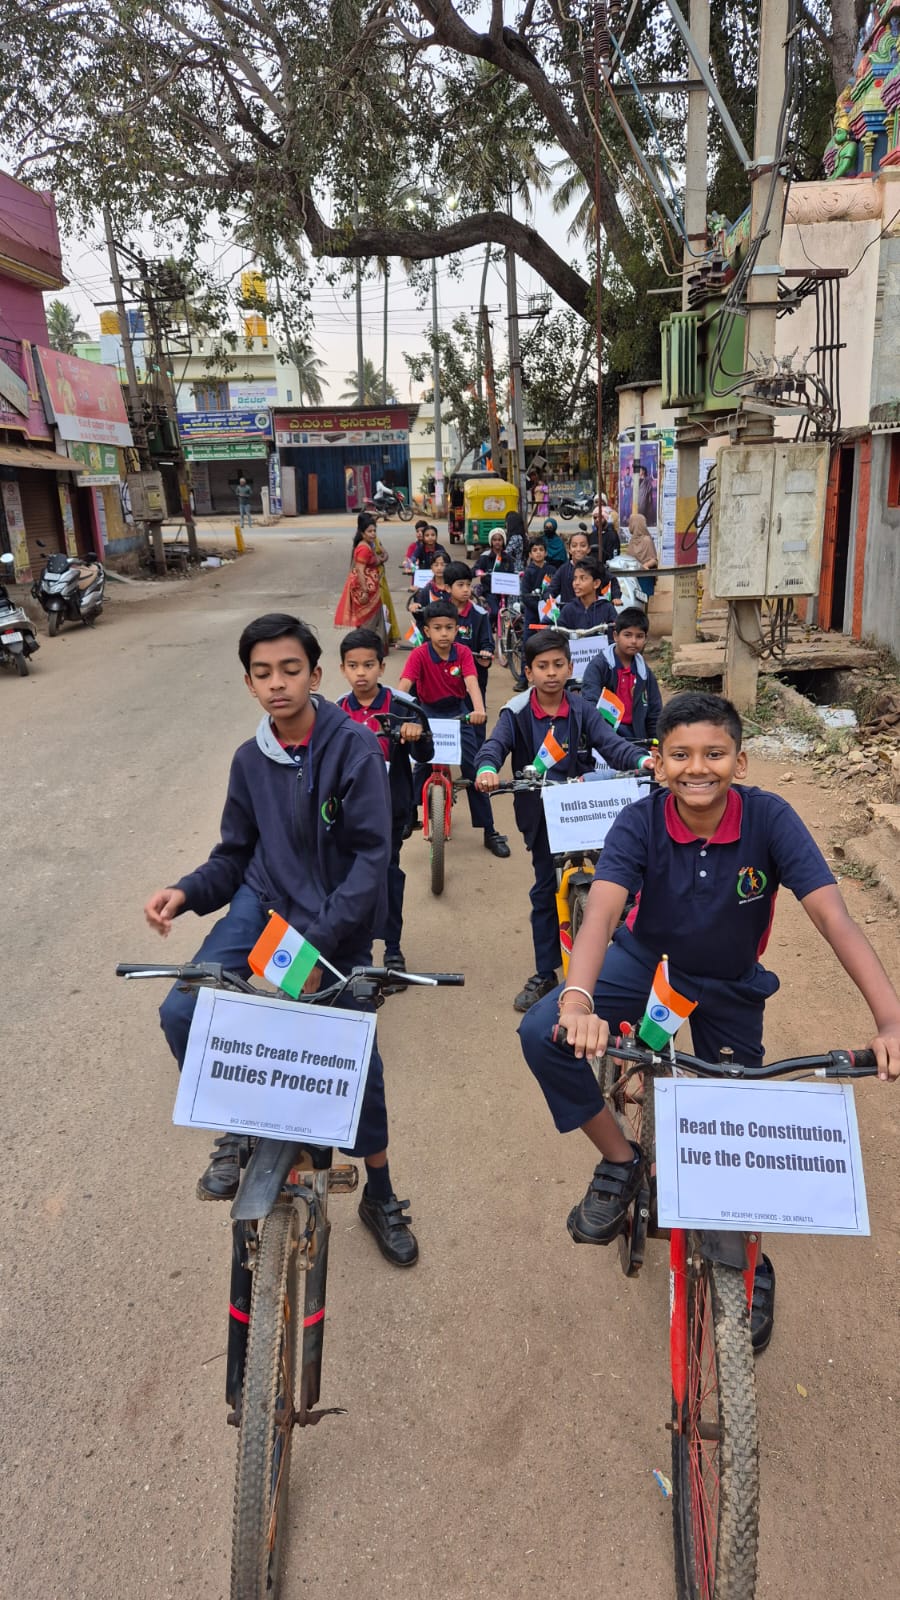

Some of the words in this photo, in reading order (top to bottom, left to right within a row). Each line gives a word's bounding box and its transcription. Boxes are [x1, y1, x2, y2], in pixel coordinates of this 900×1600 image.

[560, 800, 588, 812] India
[589, 797, 619, 809] Stands
[620, 797, 632, 806] on
[560, 811, 607, 824] Responsible
[210, 1036, 254, 1056] Rights
[255, 1043, 299, 1063] Create
[300, 1050, 358, 1073] Freedom,
[210, 1060, 267, 1086] Duties
[271, 1069, 333, 1095] Protect
[335, 1080, 350, 1098] It
[679, 1118, 717, 1136] Read
[719, 1120, 745, 1137] the
[747, 1121, 847, 1145] Constitution,
[680, 1147, 712, 1166] Live
[714, 1150, 741, 1168] the
[744, 1150, 847, 1174] Constitution
